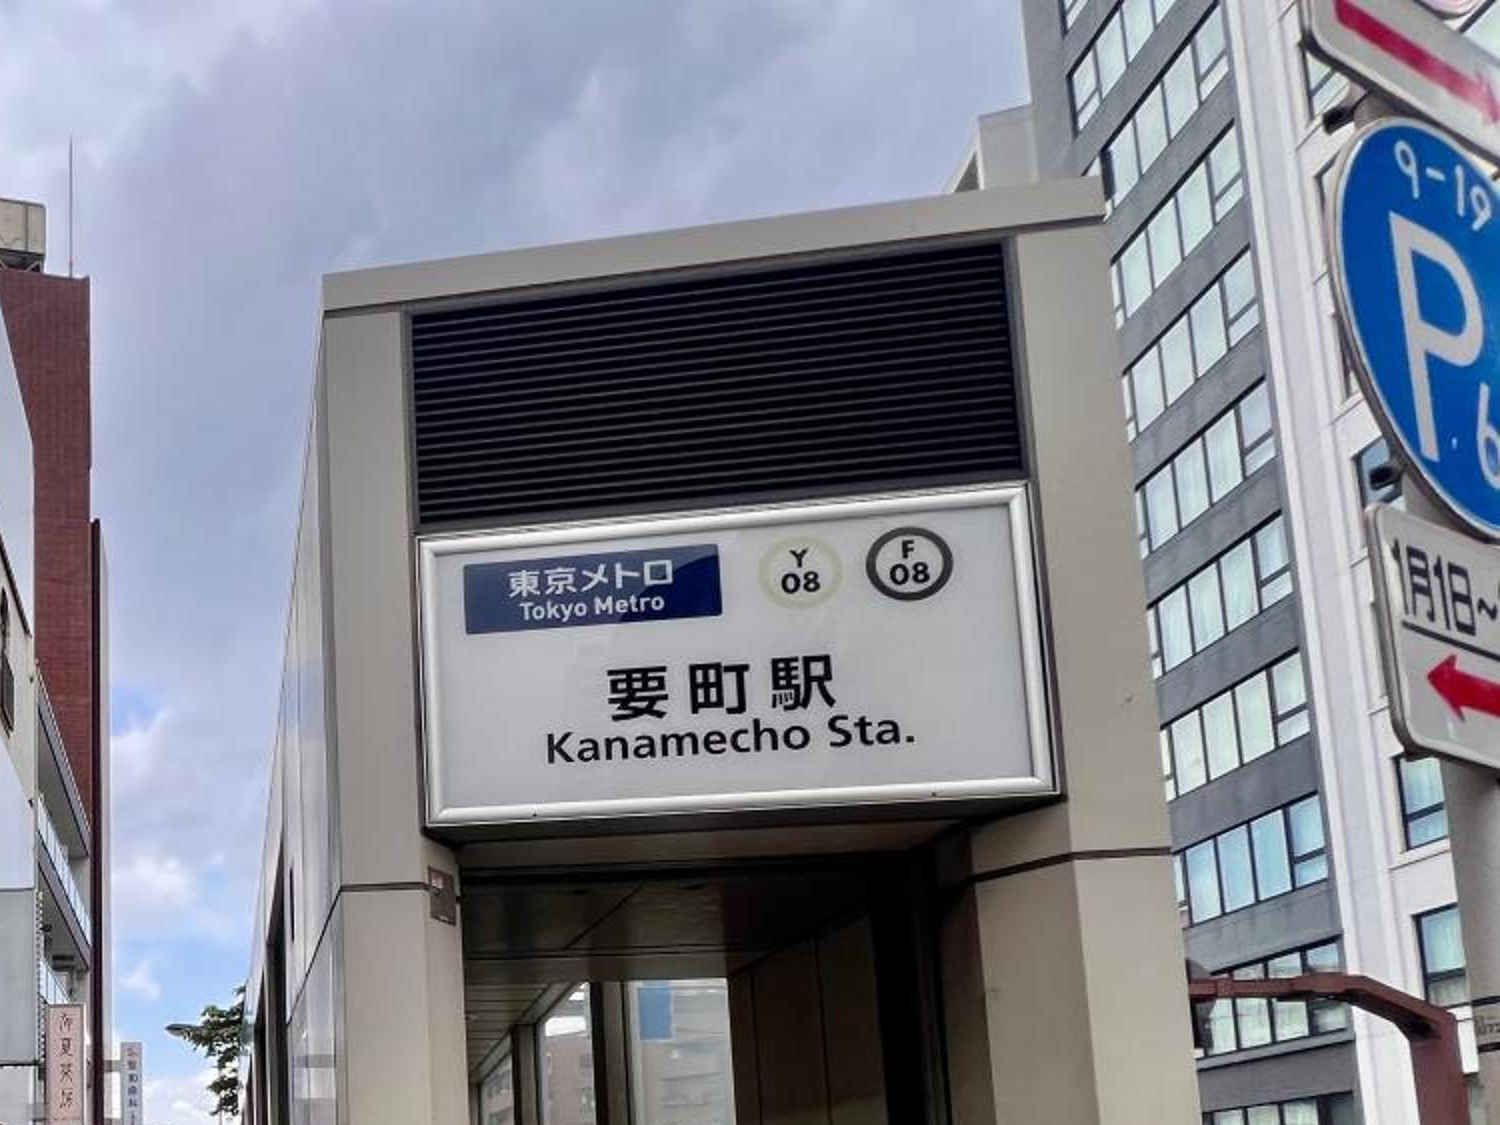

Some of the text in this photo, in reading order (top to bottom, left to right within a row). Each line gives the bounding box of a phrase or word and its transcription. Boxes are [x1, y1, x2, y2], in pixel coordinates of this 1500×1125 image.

[1394, 139, 1492, 232] 9-19
[1389, 211, 1483, 463] P
[789, 548, 808, 568] Y
[901, 540, 914, 559] F
[508, 559, 673, 598] 東京メトロ
[781, 571, 820, 594] 08
[890, 562, 930, 585] 08
[520, 595, 665, 622] Tokyo Metro
[607, 654, 837, 722] 要町駅
[546, 715, 916, 764] Kanamecho Sta.
